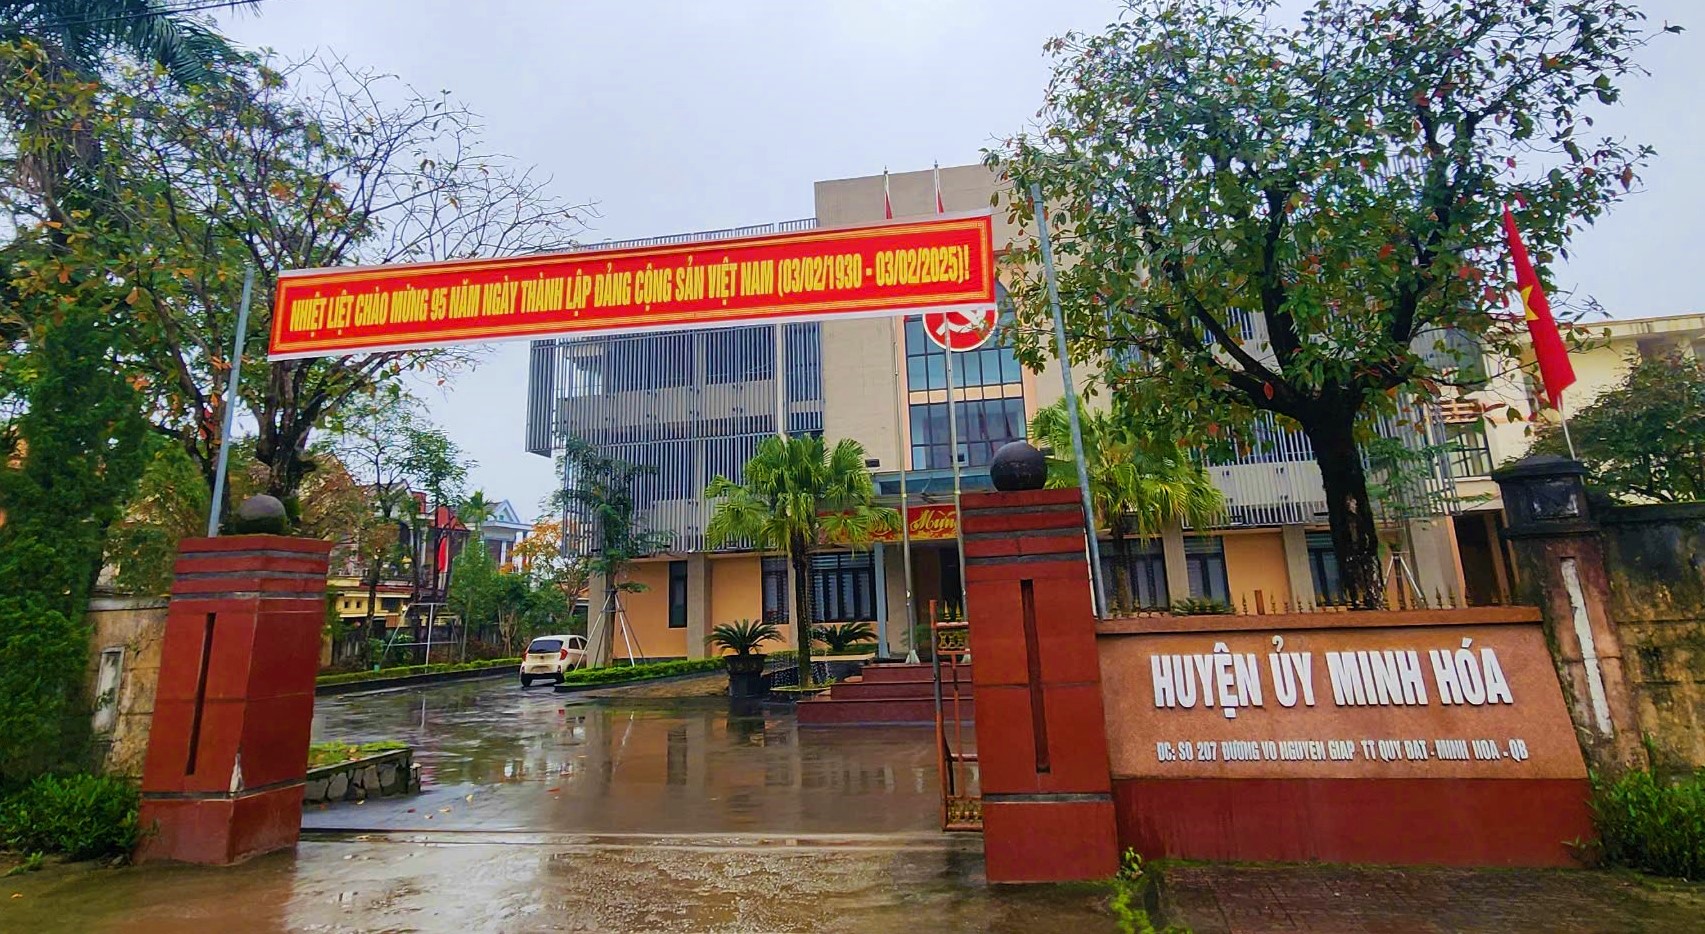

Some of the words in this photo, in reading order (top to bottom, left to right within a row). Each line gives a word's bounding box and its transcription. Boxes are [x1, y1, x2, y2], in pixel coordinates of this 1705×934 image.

[290, 291, 327, 337] NHIỆT
[327, 289, 354, 336] LIỆT
[354, 286, 388, 326] CHÀO
[390, 283, 428, 323] MỪNG
[430, 287, 448, 321] 95
[448, 278, 481, 319] NĂM
[482, 275, 518, 315] NGÀY
[520, 271, 564, 313] THÀNH
[566, 268, 591, 317] LẬP
[594, 262, 631, 307] ĐẢNG
[635, 263, 672, 311] CỘNG
[675, 255, 704, 301] SẢN
[707, 256, 737, 306] VIỆT
[741, 259, 774, 296] NAM
[778, 252, 862, 297] (03/02/1930
[875, 244, 970, 288] 03/02/2025)!
[909, 509, 958, 533] Mừn
[1150, 641, 1263, 719] HUYỆN
[1268, 635, 1315, 707] ỦY
[1325, 650, 1428, 706] MINH
[1429, 637, 1514, 705] HÓA
[1197, 740, 1217, 761] 207
[1360, 740, 1376, 760] TT
[1435, 739, 1470, 760] MINH
[1509, 738, 1529, 762] QB
